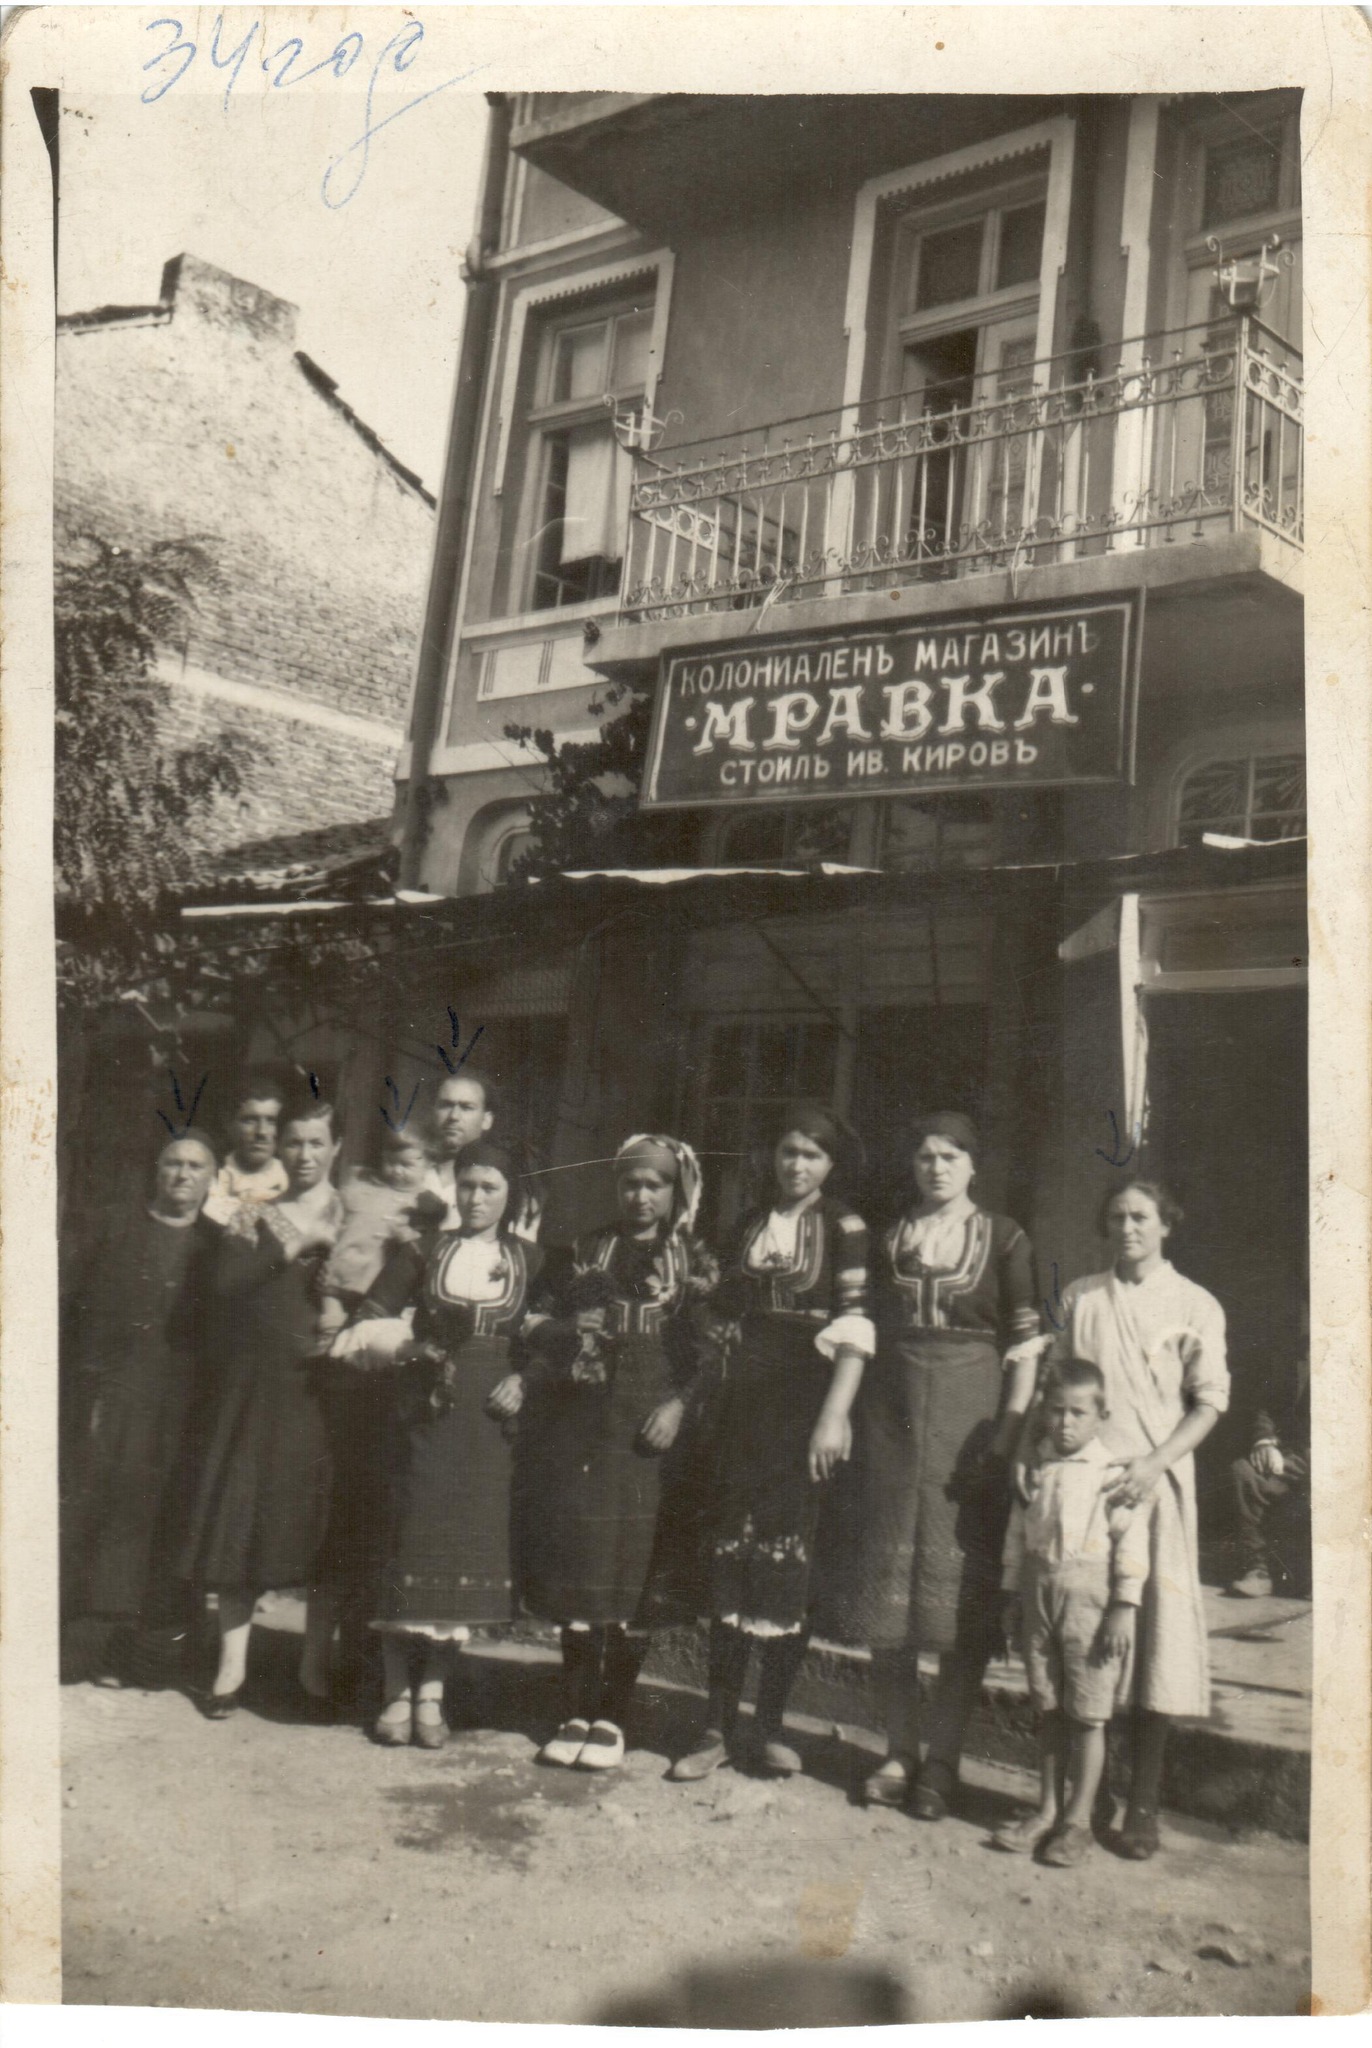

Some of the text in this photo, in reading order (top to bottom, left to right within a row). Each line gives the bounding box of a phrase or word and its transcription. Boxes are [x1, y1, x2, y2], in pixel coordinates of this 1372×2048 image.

[681, 621, 1100, 697] КОЛОНИАЛЕНЪ МАГАЗИНЪ
[693, 665, 1079, 754] МРАВКА
[720, 740, 1038, 786] СТОИЛЪ ИВ. КИРОВЪ
